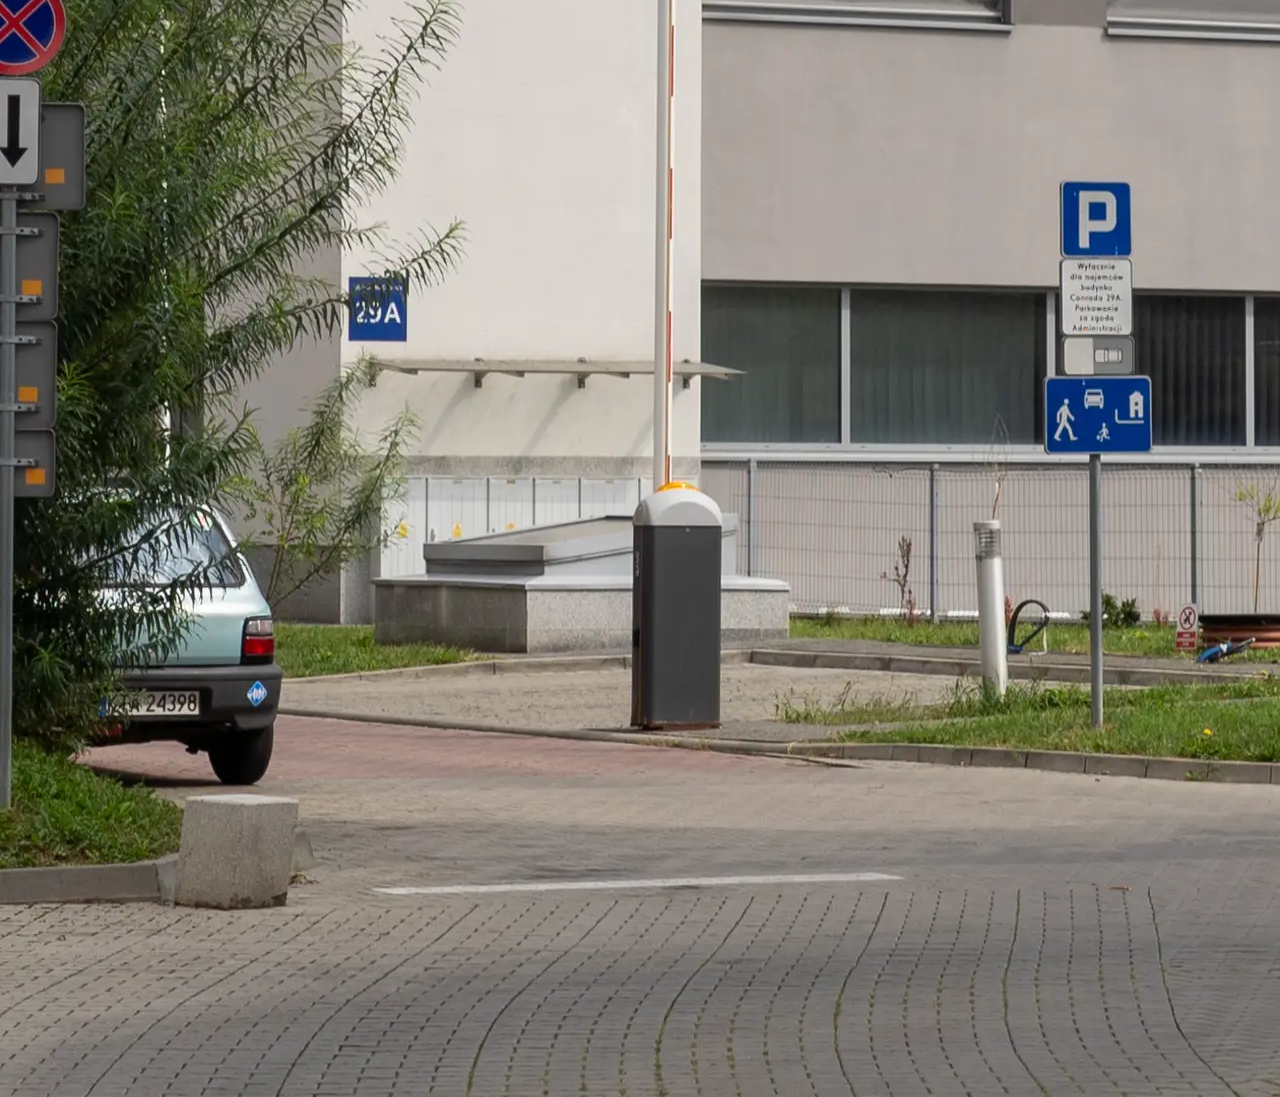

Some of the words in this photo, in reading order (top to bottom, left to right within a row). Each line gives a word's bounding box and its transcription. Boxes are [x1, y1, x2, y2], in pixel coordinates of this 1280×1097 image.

[1078, 190, 1117, 249] P
[1085, 273, 1124, 282] najemców
[1080, 284, 1113, 292] budynku
[1070, 294, 1103, 302] Conrada
[356, 301, 401, 324] 29A
[1075, 304, 1119, 312] Parkowanie
[1072, 324, 1123, 334] Administracji
[146, 693, 198, 713] 24398
